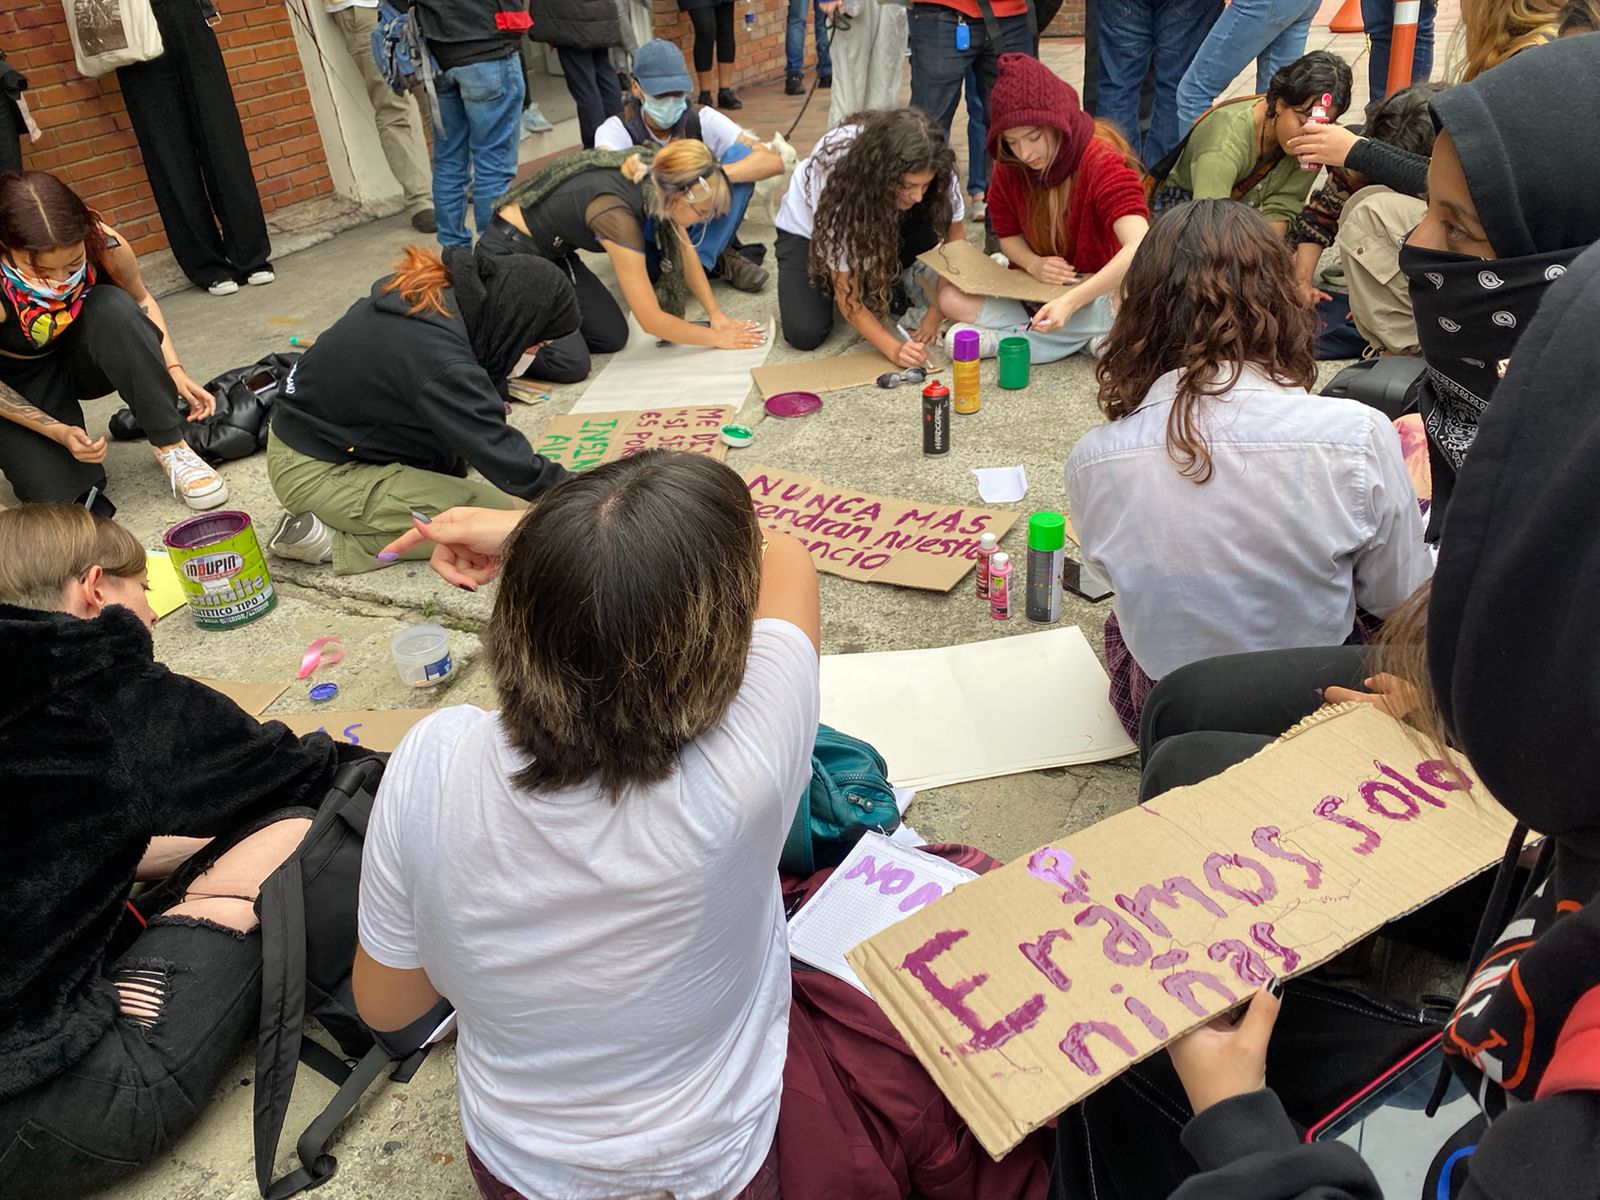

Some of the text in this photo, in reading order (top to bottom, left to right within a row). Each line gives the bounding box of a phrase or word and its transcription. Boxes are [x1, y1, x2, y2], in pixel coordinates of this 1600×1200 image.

[635, 411, 662, 428] ES
[696, 408, 726, 427] ME
[748, 474, 992, 534] NUNCA MAS
[236, 597, 259, 612] TIPO
[1313, 758, 1475, 856] solo
[844, 855, 915, 895] NO
[1059, 921, 1301, 1077] niñas
